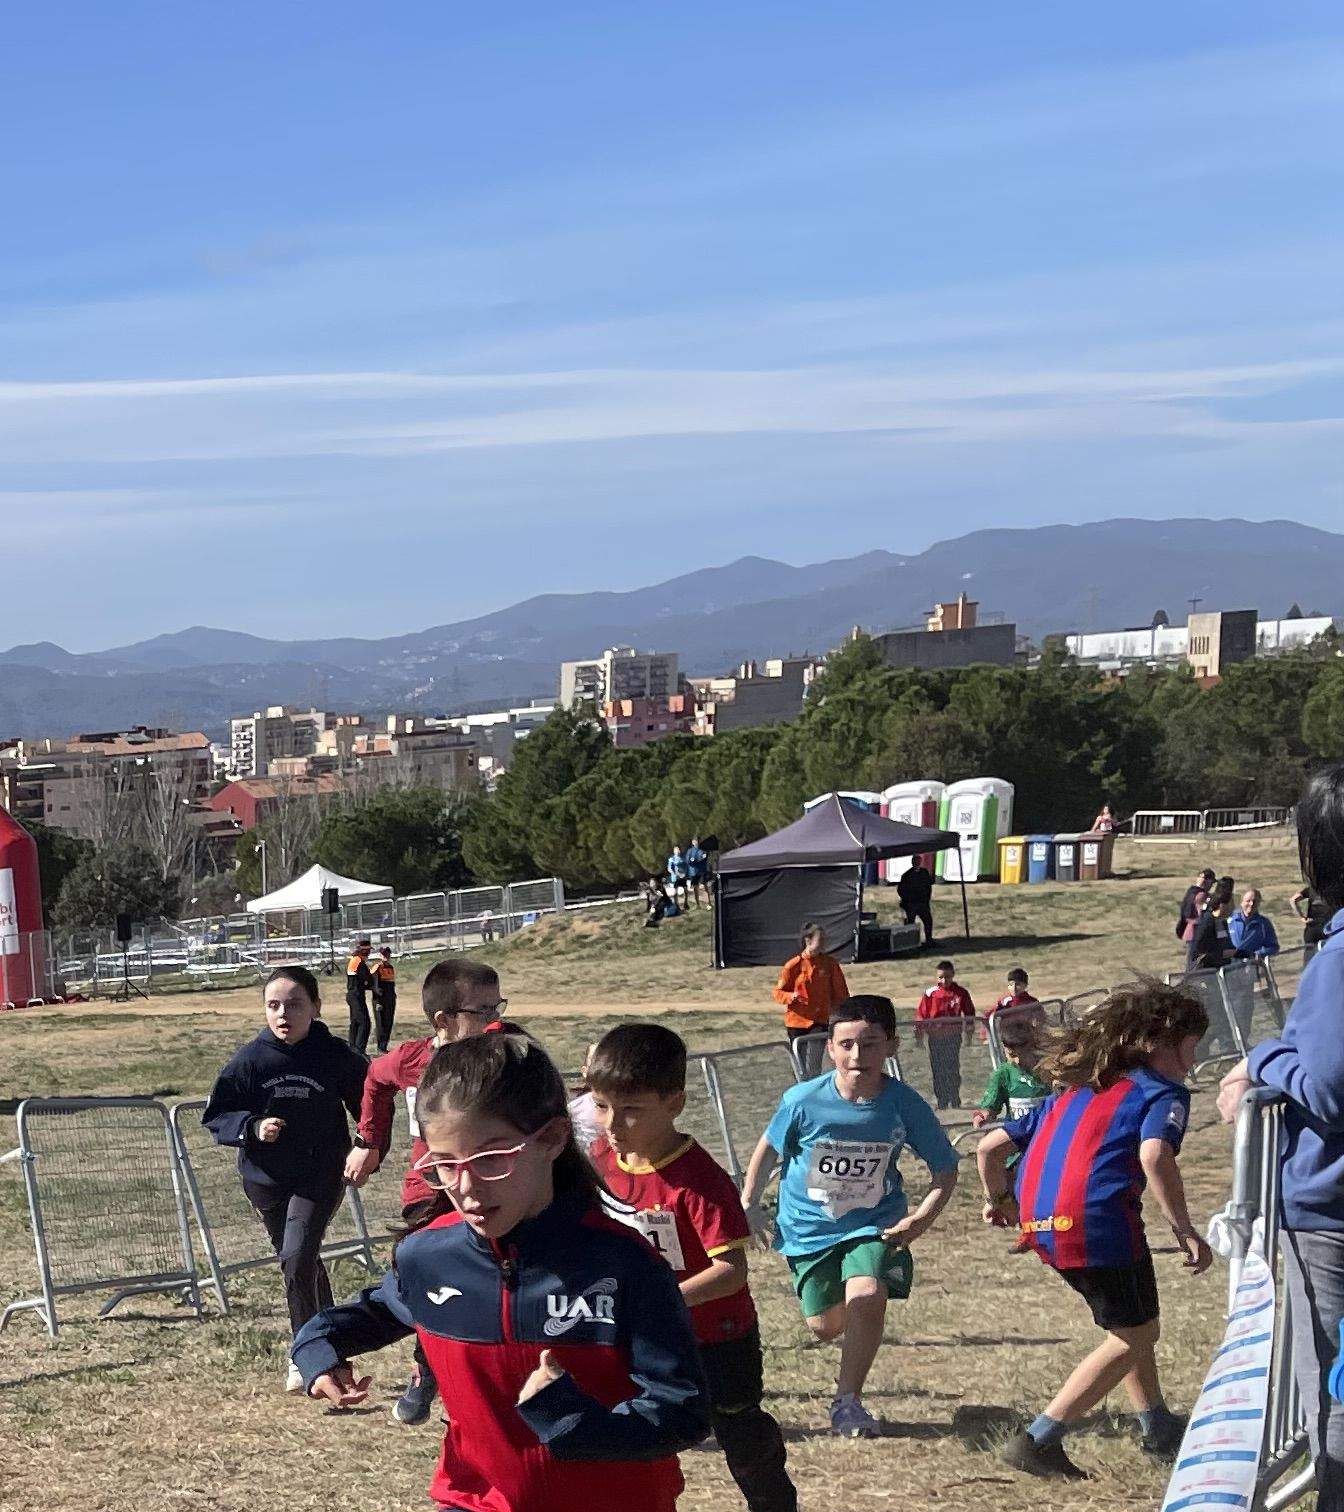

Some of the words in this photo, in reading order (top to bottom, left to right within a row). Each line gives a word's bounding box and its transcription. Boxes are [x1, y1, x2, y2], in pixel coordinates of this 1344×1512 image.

[818, 1155, 882, 1178] 6057
[1023, 1215, 1055, 1234] nicef
[546, 1294, 615, 1319] UAR
